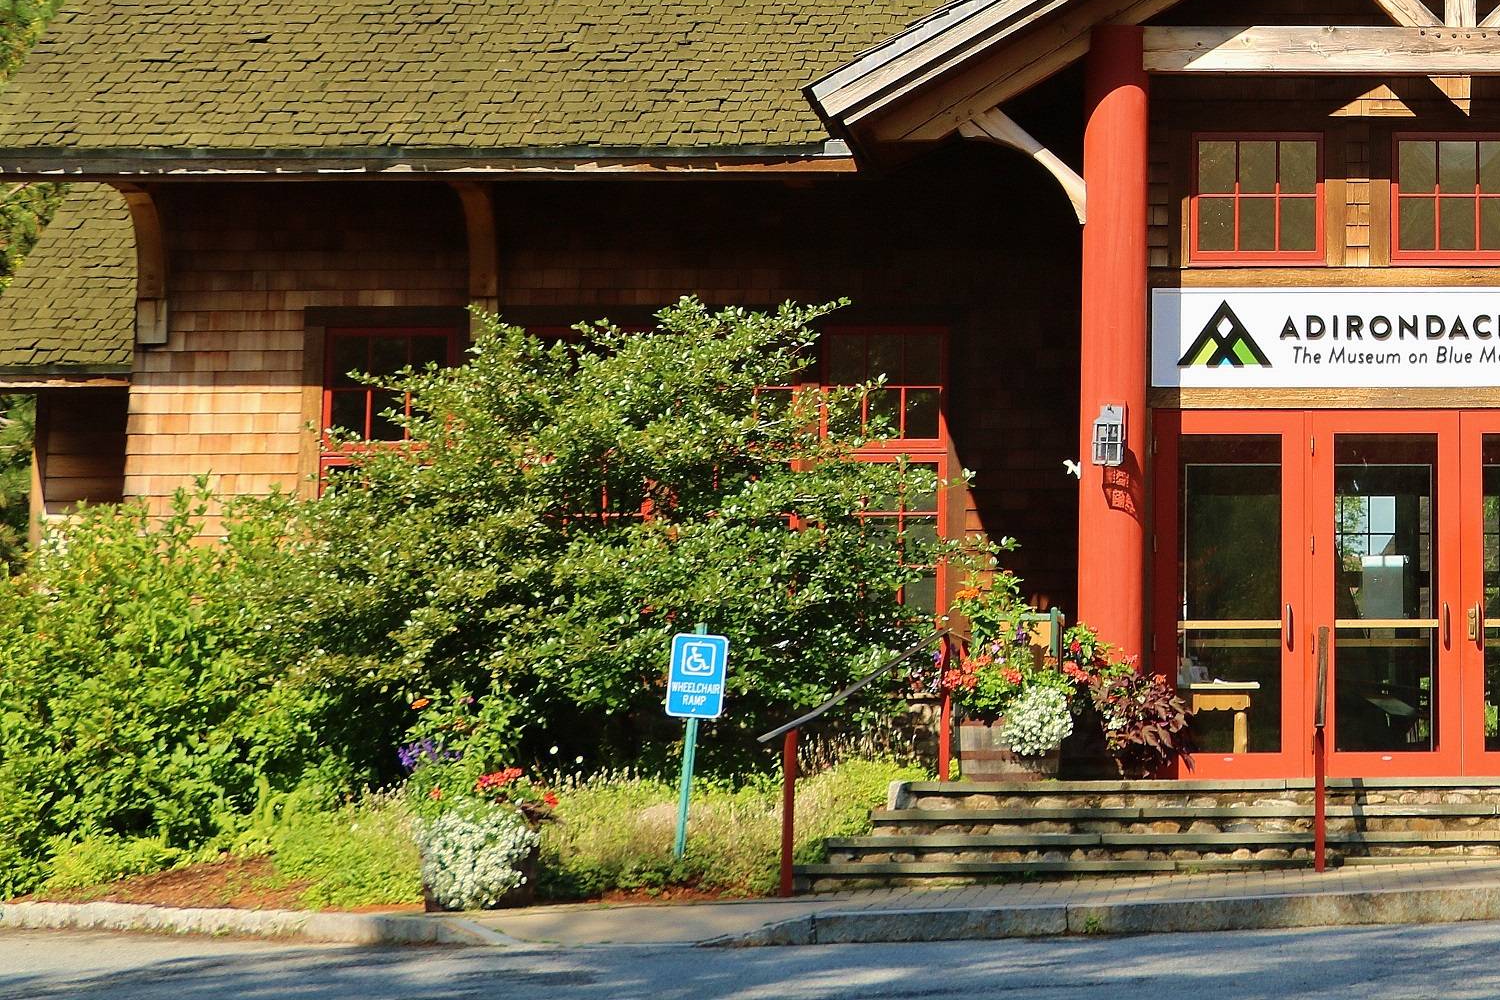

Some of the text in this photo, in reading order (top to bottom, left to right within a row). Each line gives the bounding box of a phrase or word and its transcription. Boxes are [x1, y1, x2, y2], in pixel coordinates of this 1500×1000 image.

[1292, 346, 1322, 365] The
[1328, 346, 1401, 365] Museum
[1408, 353, 1429, 365] on
[1436, 346, 1473, 364] Blue
[672, 682, 721, 694] WHEELCHAIR
[682, 695, 707, 705] RAMP
